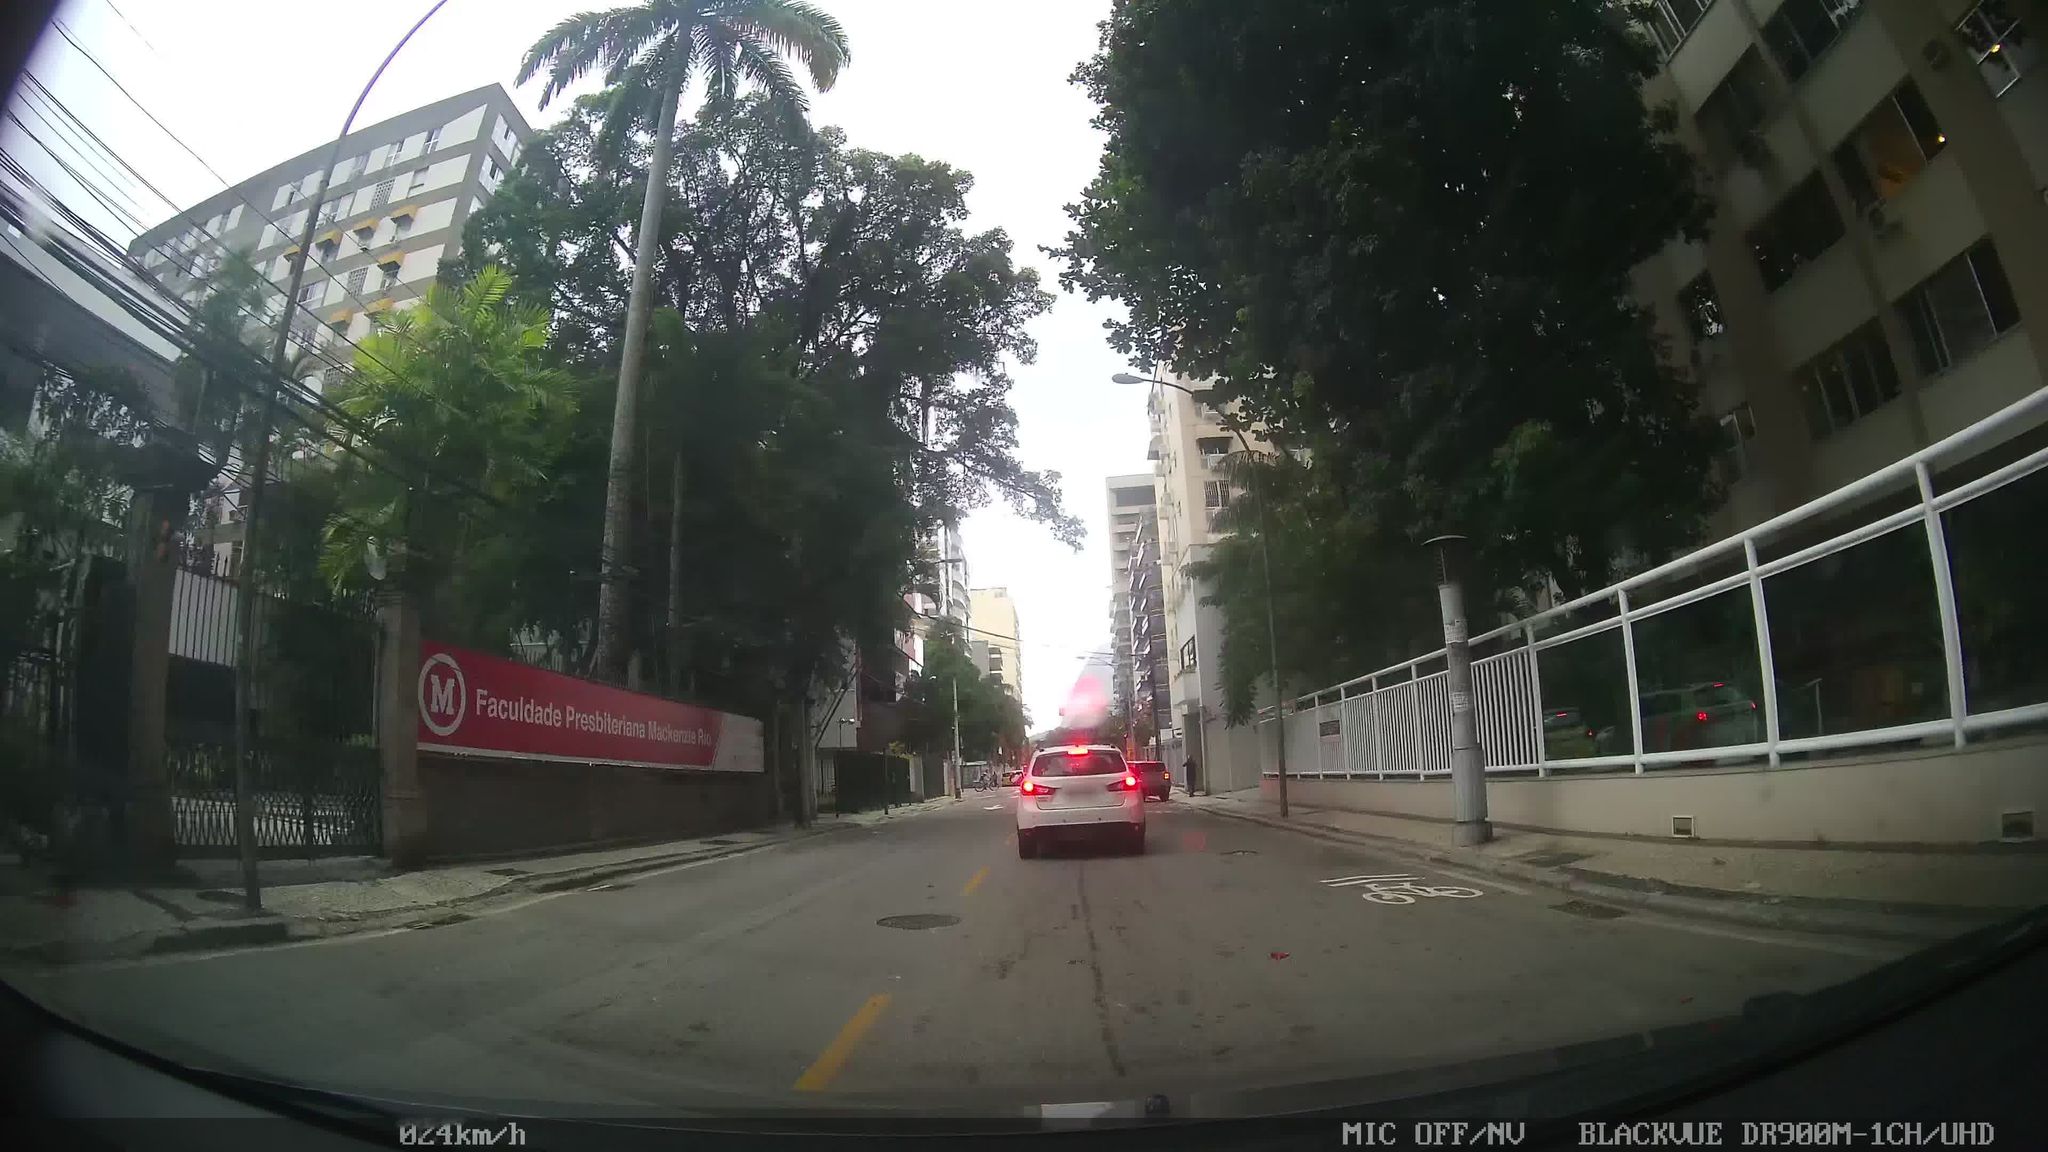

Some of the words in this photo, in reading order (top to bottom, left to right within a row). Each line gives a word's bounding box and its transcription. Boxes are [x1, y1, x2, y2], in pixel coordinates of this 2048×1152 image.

[430, 674, 455, 715] M
[476, 688, 562, 728] Faculdade
[566, 706, 646, 739] Presbiteriana
[648, 720, 697, 745] Mackenzie
[698, 729, 711, 746] Rio
